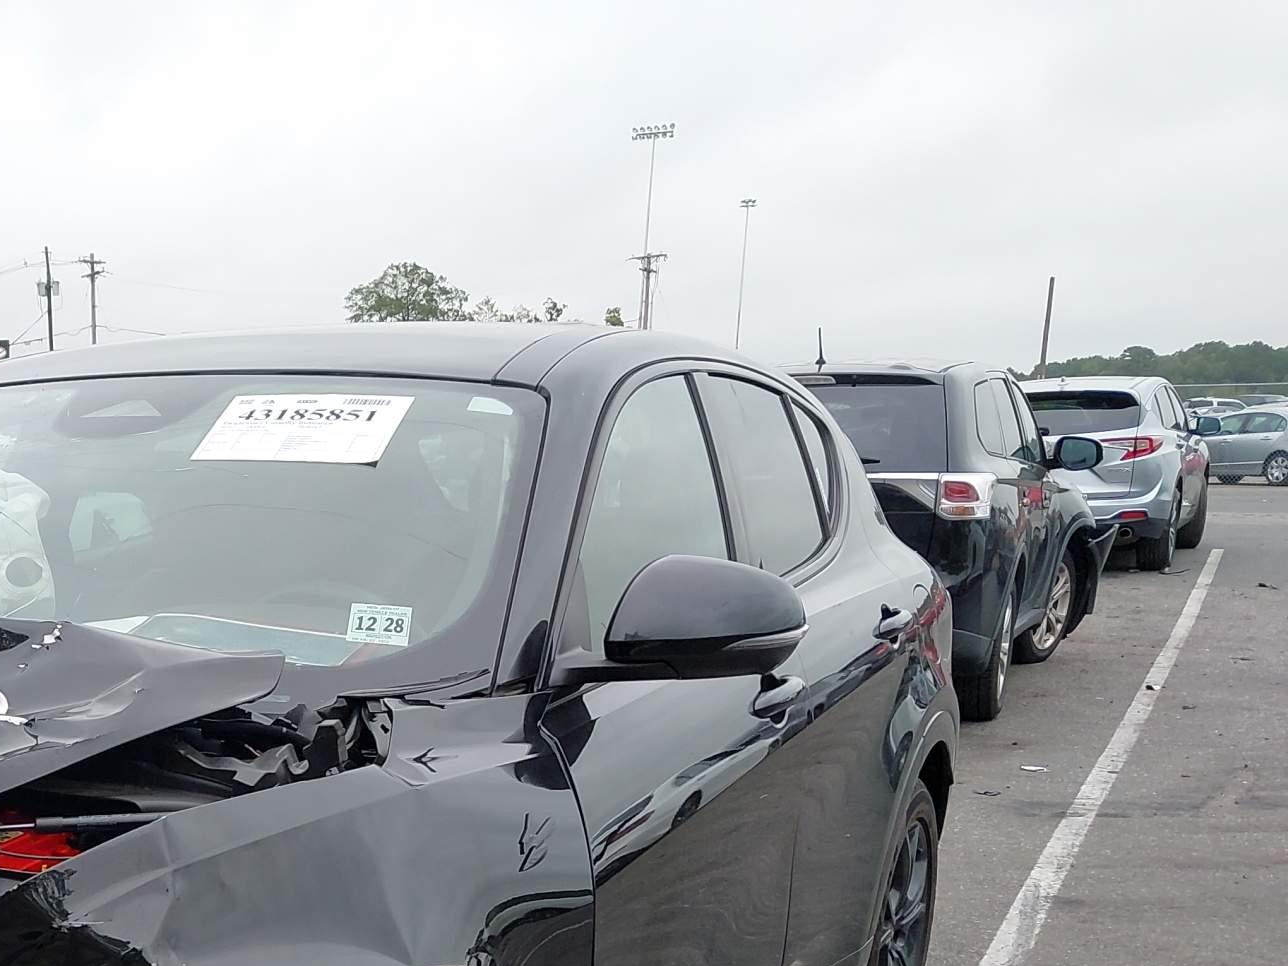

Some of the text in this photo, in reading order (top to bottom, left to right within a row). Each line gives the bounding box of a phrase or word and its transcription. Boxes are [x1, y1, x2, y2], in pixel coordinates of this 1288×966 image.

[238, 408, 377, 421] 43185851
[355, 616, 404, 633] 12 28
